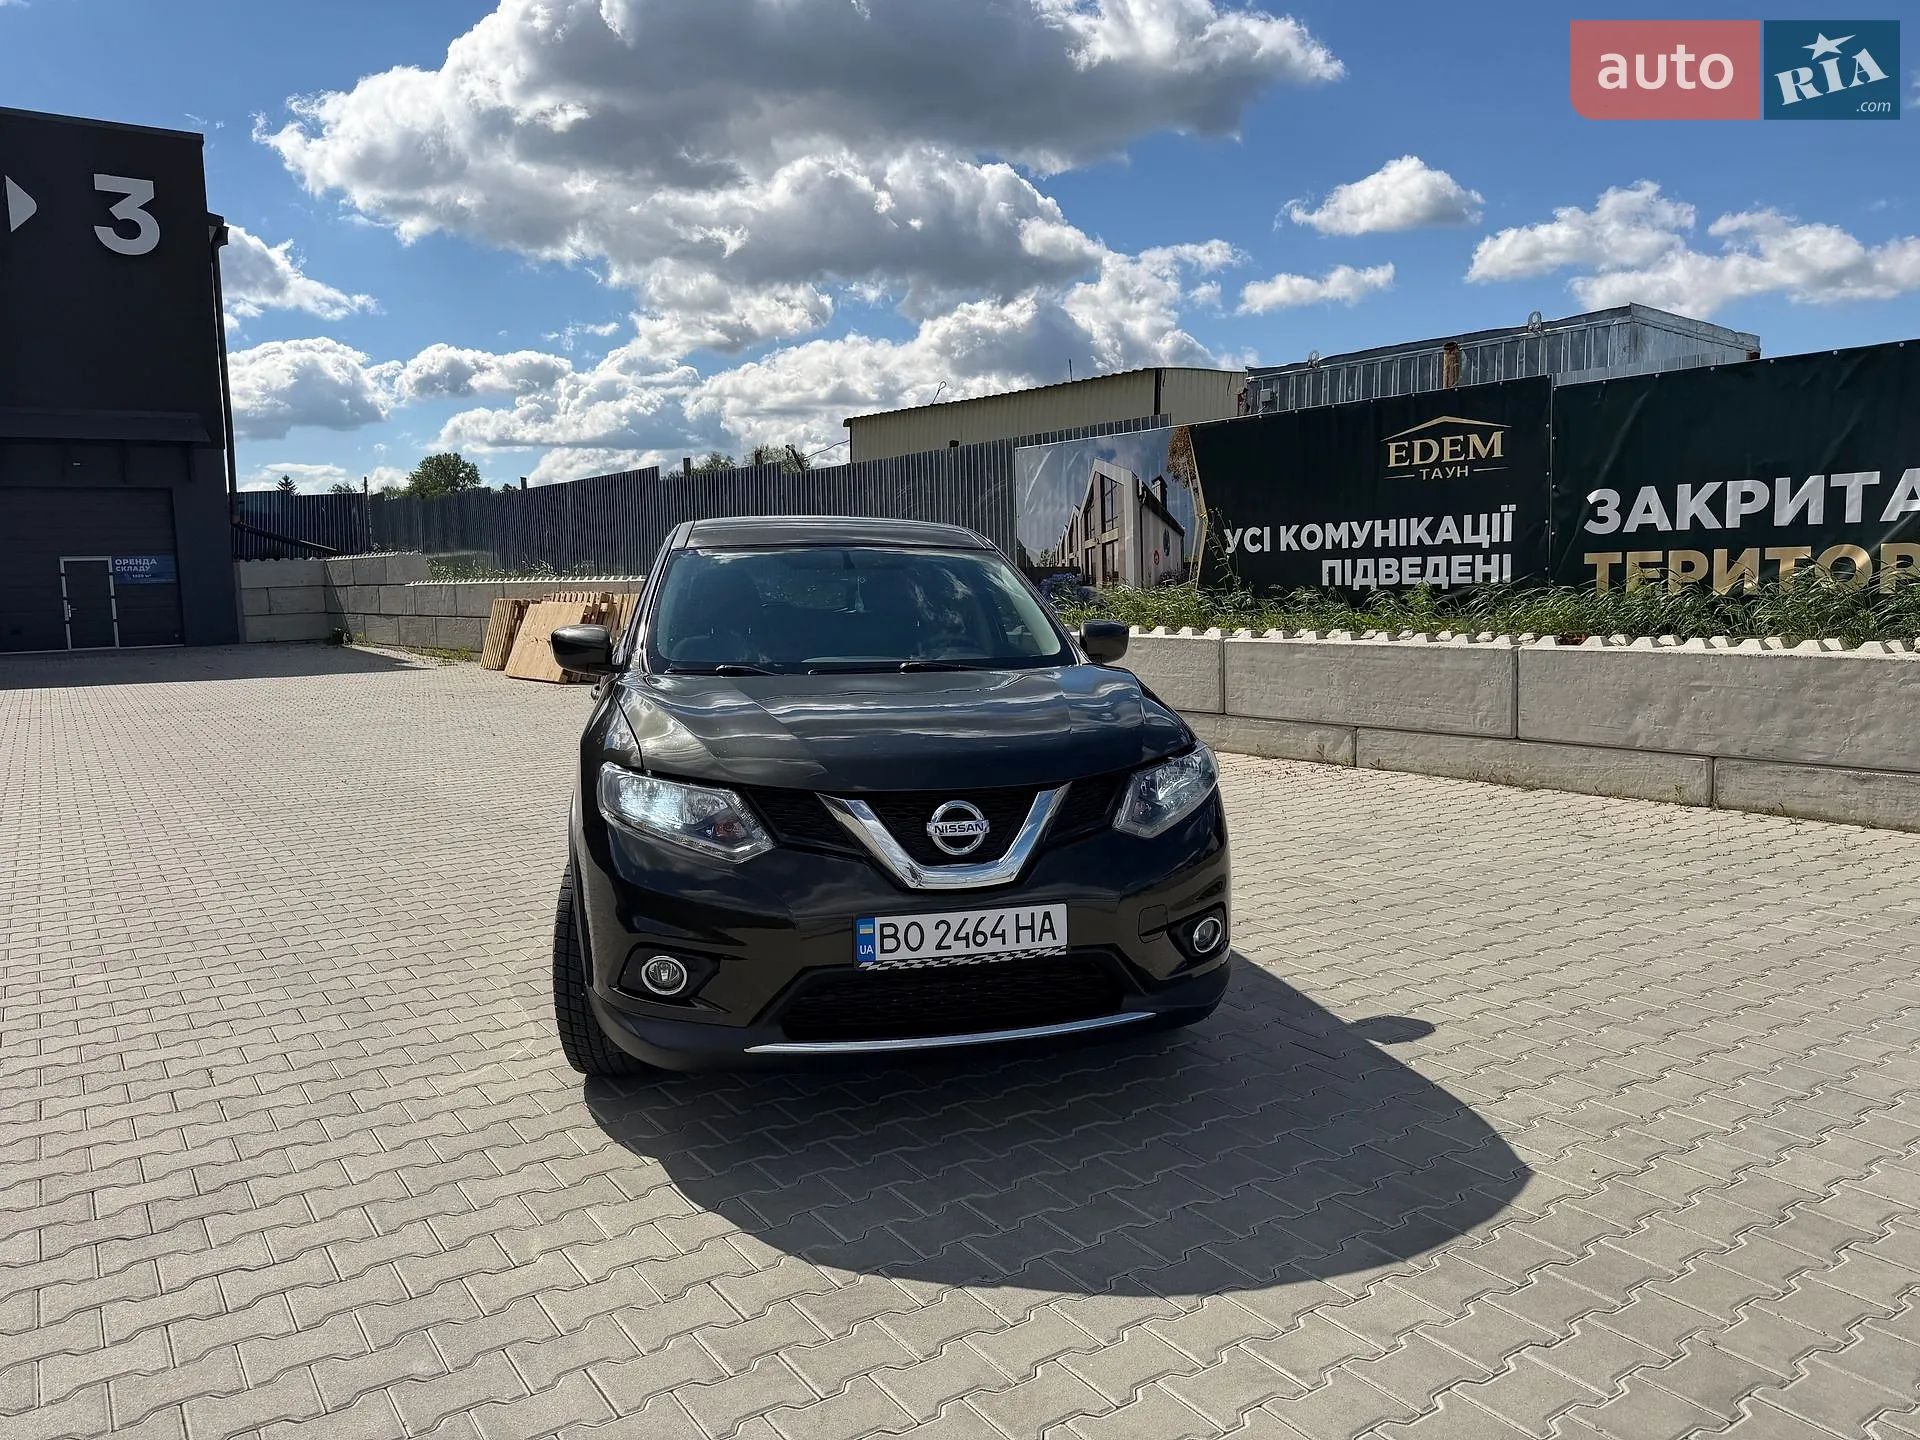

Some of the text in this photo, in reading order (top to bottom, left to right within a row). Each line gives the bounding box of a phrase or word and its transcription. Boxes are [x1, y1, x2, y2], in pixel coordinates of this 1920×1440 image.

[94, 173, 160, 255] 3
[1387, 431, 1504, 468] EDEM
[1420, 465, 1469, 481] ТАУН
[1583, 468, 1920, 535] ЗАКРИТА
[1224, 504, 1517, 554] УСІ КОМУНІКАЦІЇ
[115, 558, 157, 566] ОРЕНДА
[1322, 552, 1511, 590] ПІДВЕДЕНІ
[934, 822, 984, 834] NISSAN
[860, 946, 874, 955] UA
[879, 911, 1057, 954] BO 2464 HA
